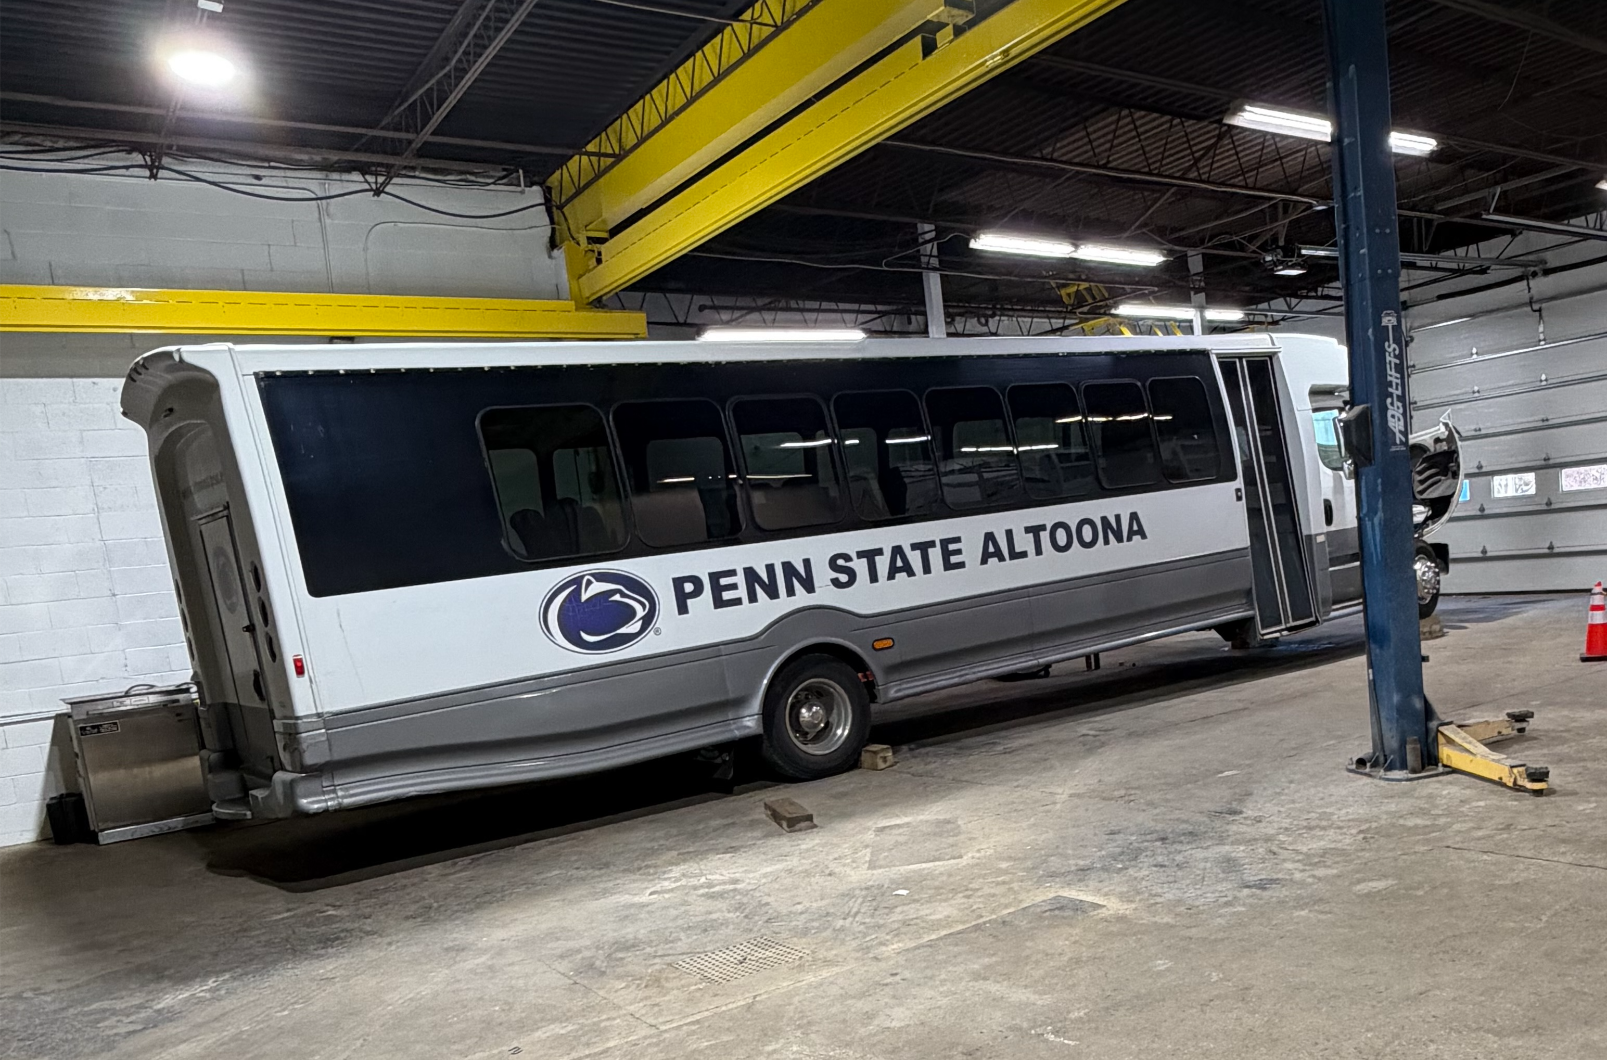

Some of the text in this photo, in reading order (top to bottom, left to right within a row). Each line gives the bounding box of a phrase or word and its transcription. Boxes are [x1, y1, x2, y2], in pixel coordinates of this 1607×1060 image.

[1385, 341, 1403, 396] LIFTS
[671, 511, 1149, 616] PENN STATE ALTOONA
